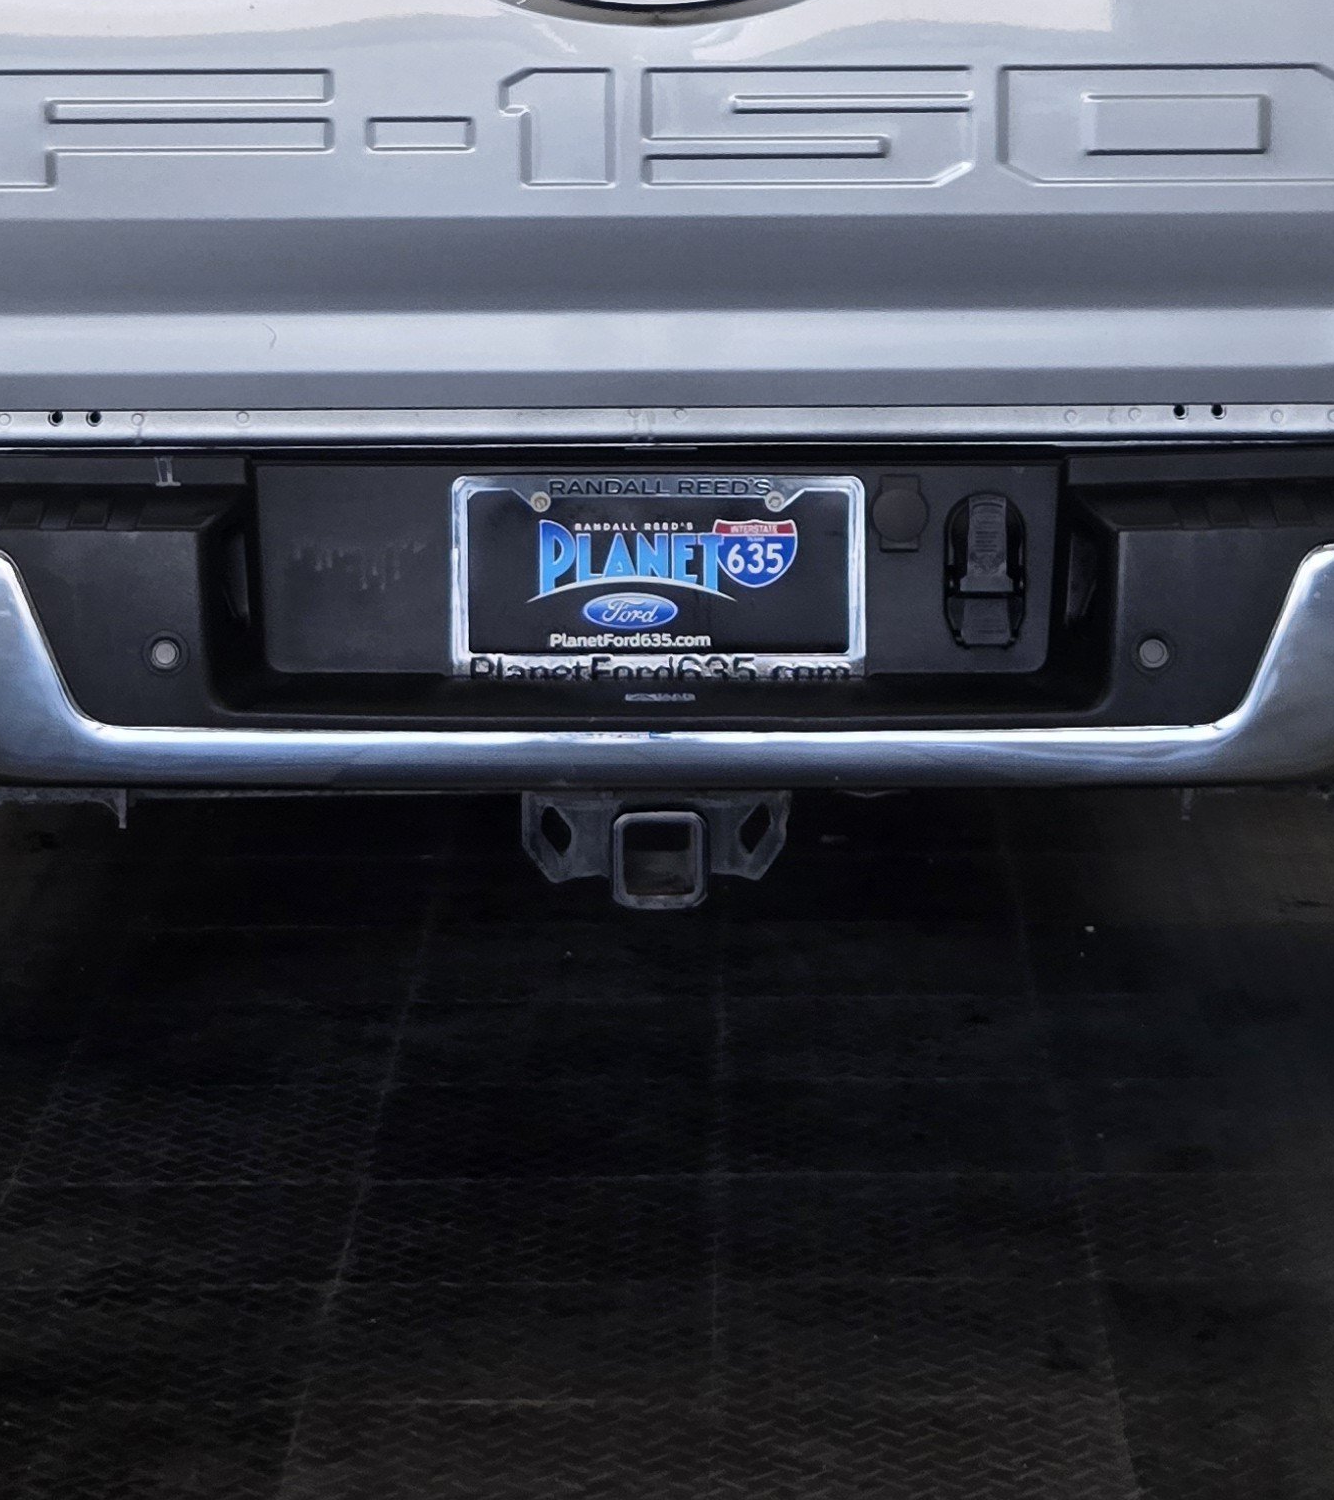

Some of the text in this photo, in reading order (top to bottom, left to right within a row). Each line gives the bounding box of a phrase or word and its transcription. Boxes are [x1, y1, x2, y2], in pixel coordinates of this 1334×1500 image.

[548, 477, 772, 497] RANDALL REED'S
[574, 522, 638, 531] RANDALL
[539, 519, 725, 596] PLANET
[727, 542, 784, 575] 635
[600, 600, 658, 624] Ford
[549, 632, 712, 648] PlanetFord635.com
[470, 655, 851, 680] PlanetFord635com
